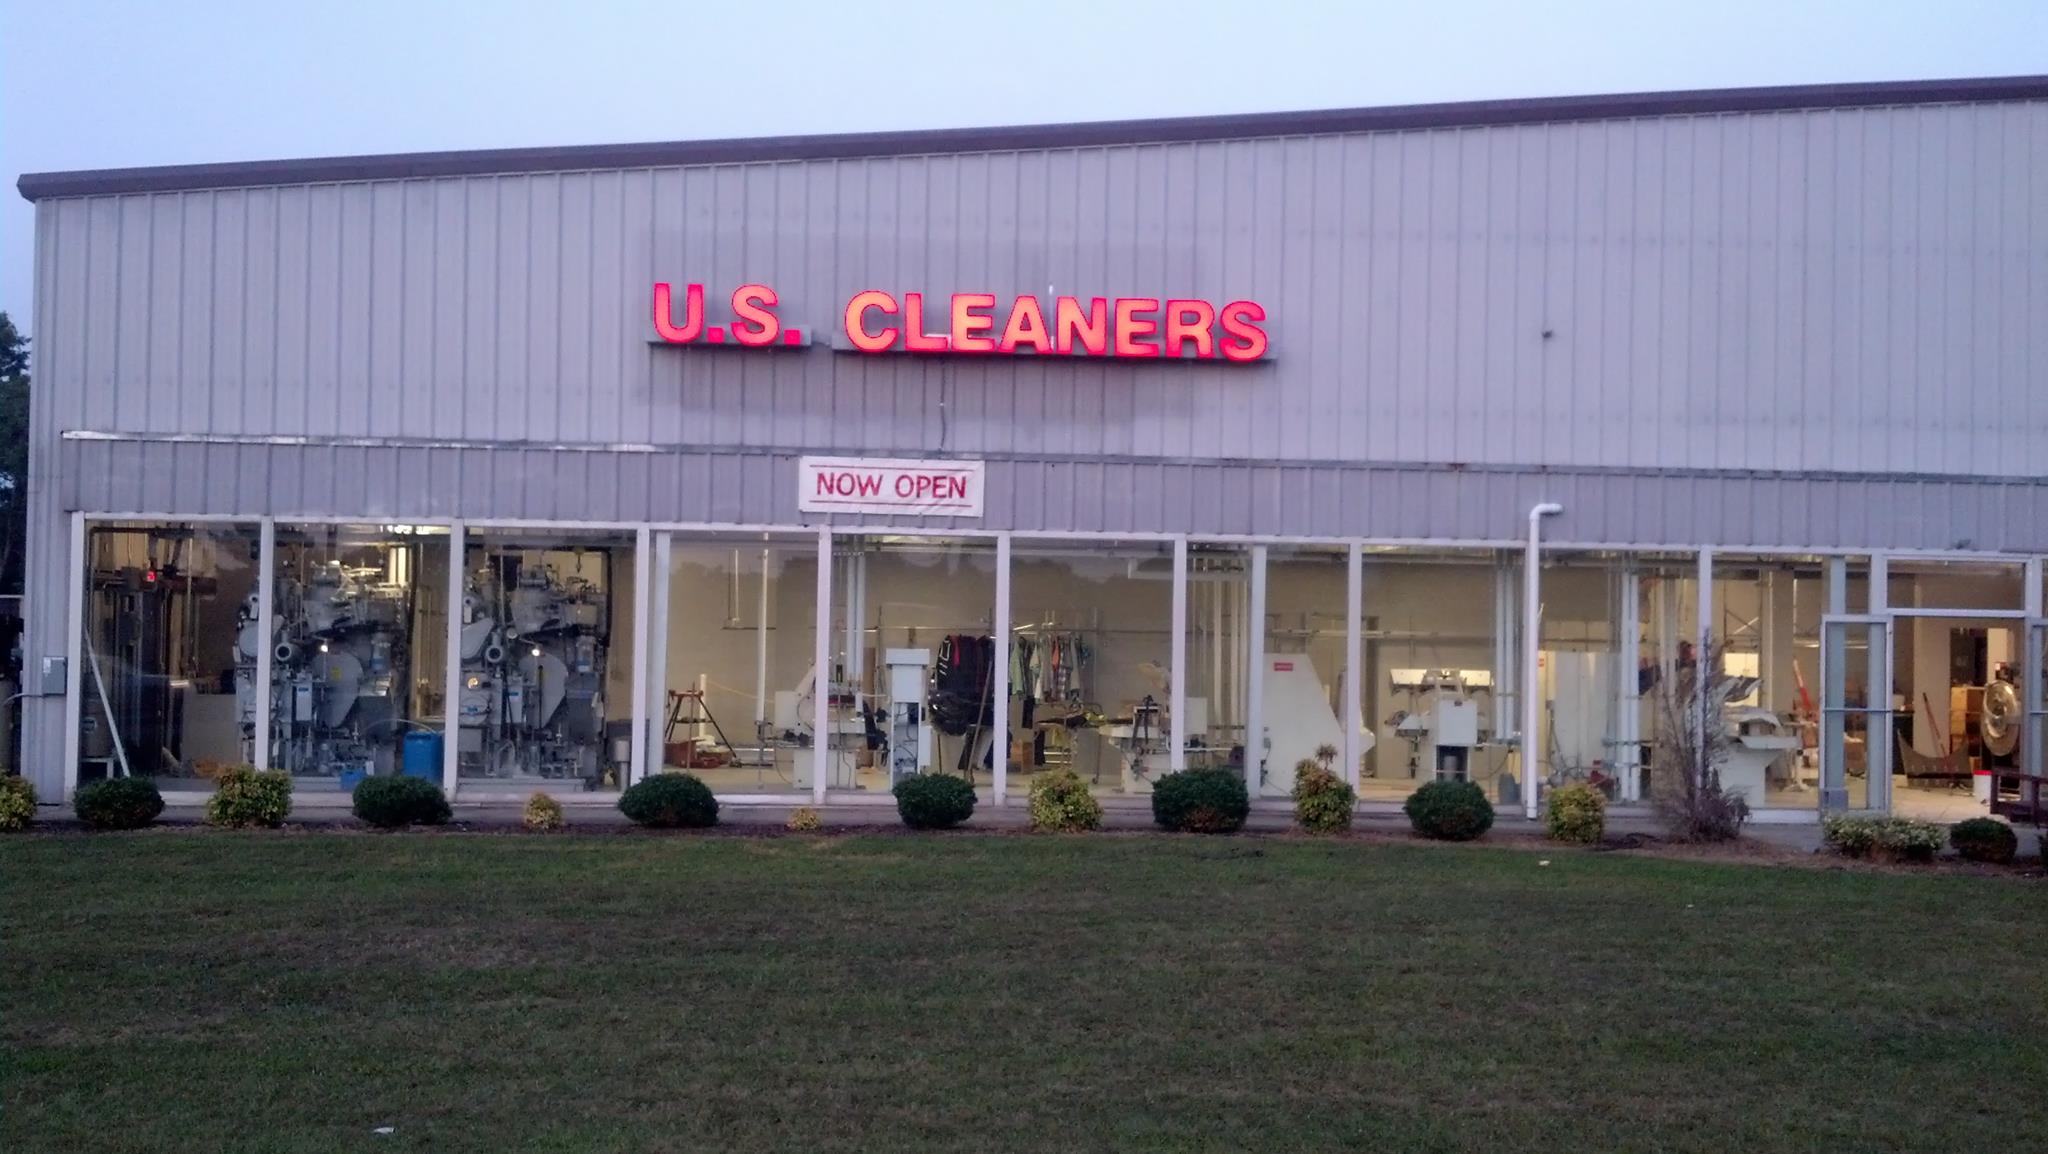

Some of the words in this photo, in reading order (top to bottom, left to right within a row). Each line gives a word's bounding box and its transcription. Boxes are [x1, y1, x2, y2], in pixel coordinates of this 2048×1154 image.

[653, 282, 801, 346] U.S.
[844, 289, 1268, 361] CLEANERS
[817, 472, 883, 497] NOW
[895, 474, 967, 499] OPEN
